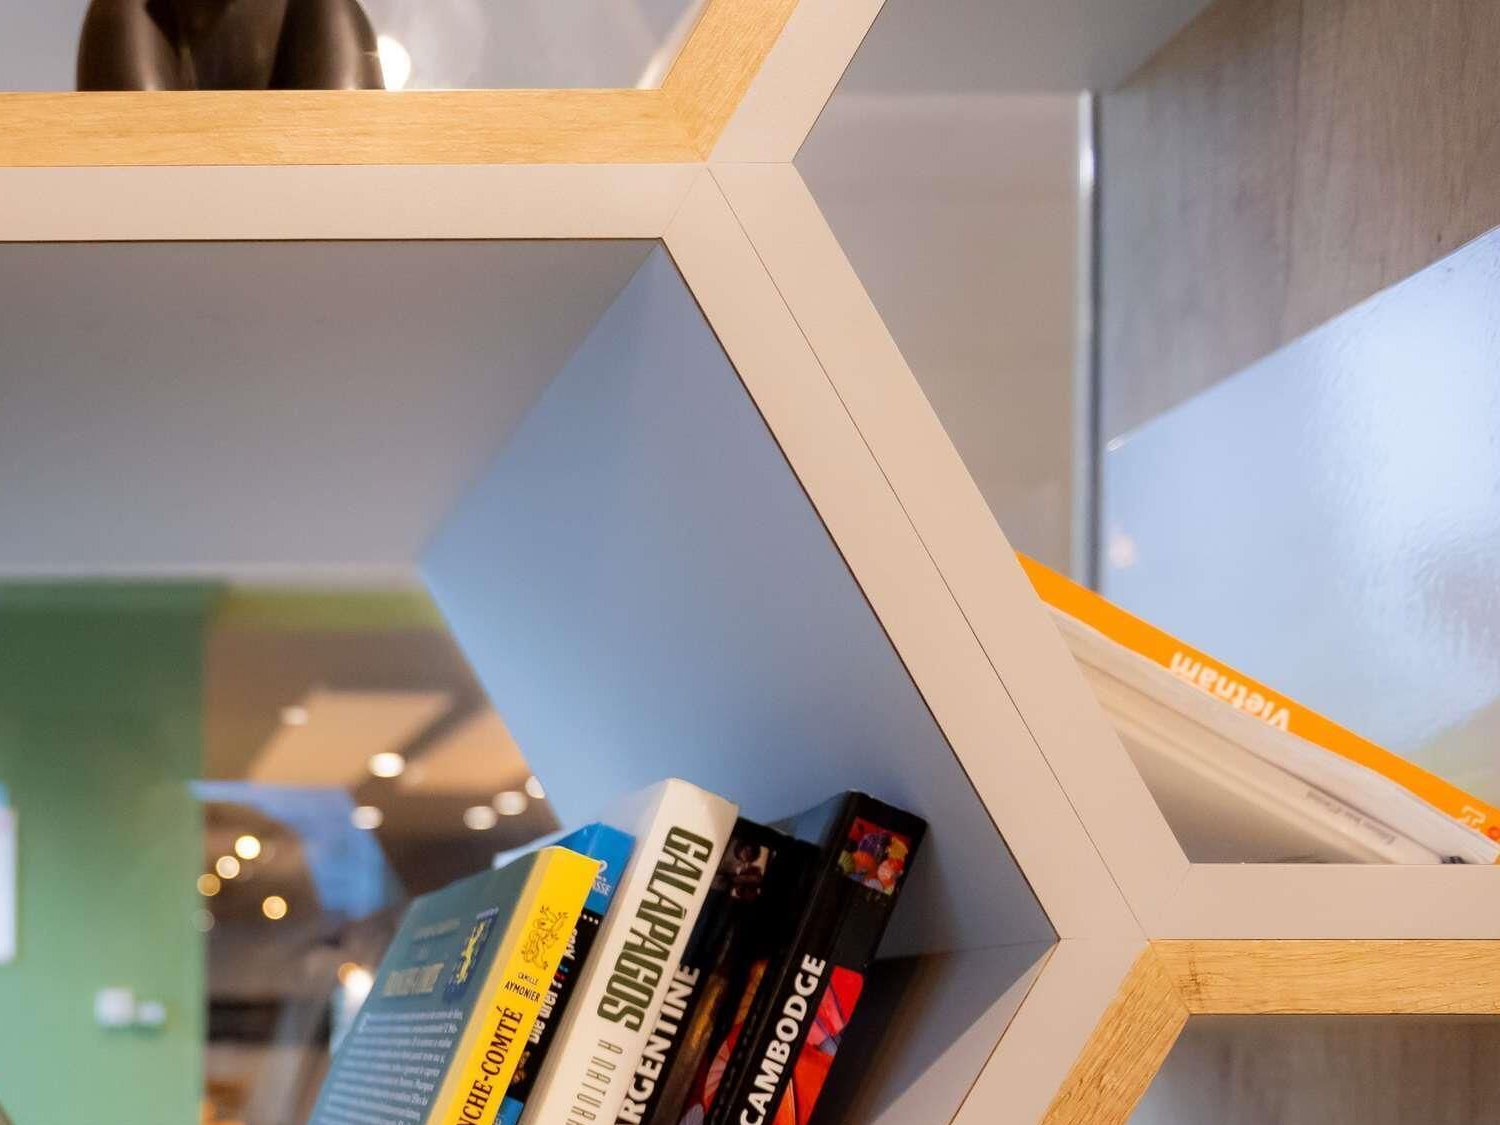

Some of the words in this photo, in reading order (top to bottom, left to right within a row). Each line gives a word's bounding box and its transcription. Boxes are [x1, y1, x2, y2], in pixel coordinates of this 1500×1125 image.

[1171, 651, 1292, 733] Vietnam
[597, 826, 714, 1032] GALÁPAGOS
[504, 980, 541, 1003] AYMONIER
[597, 1039, 623, 1055] A
